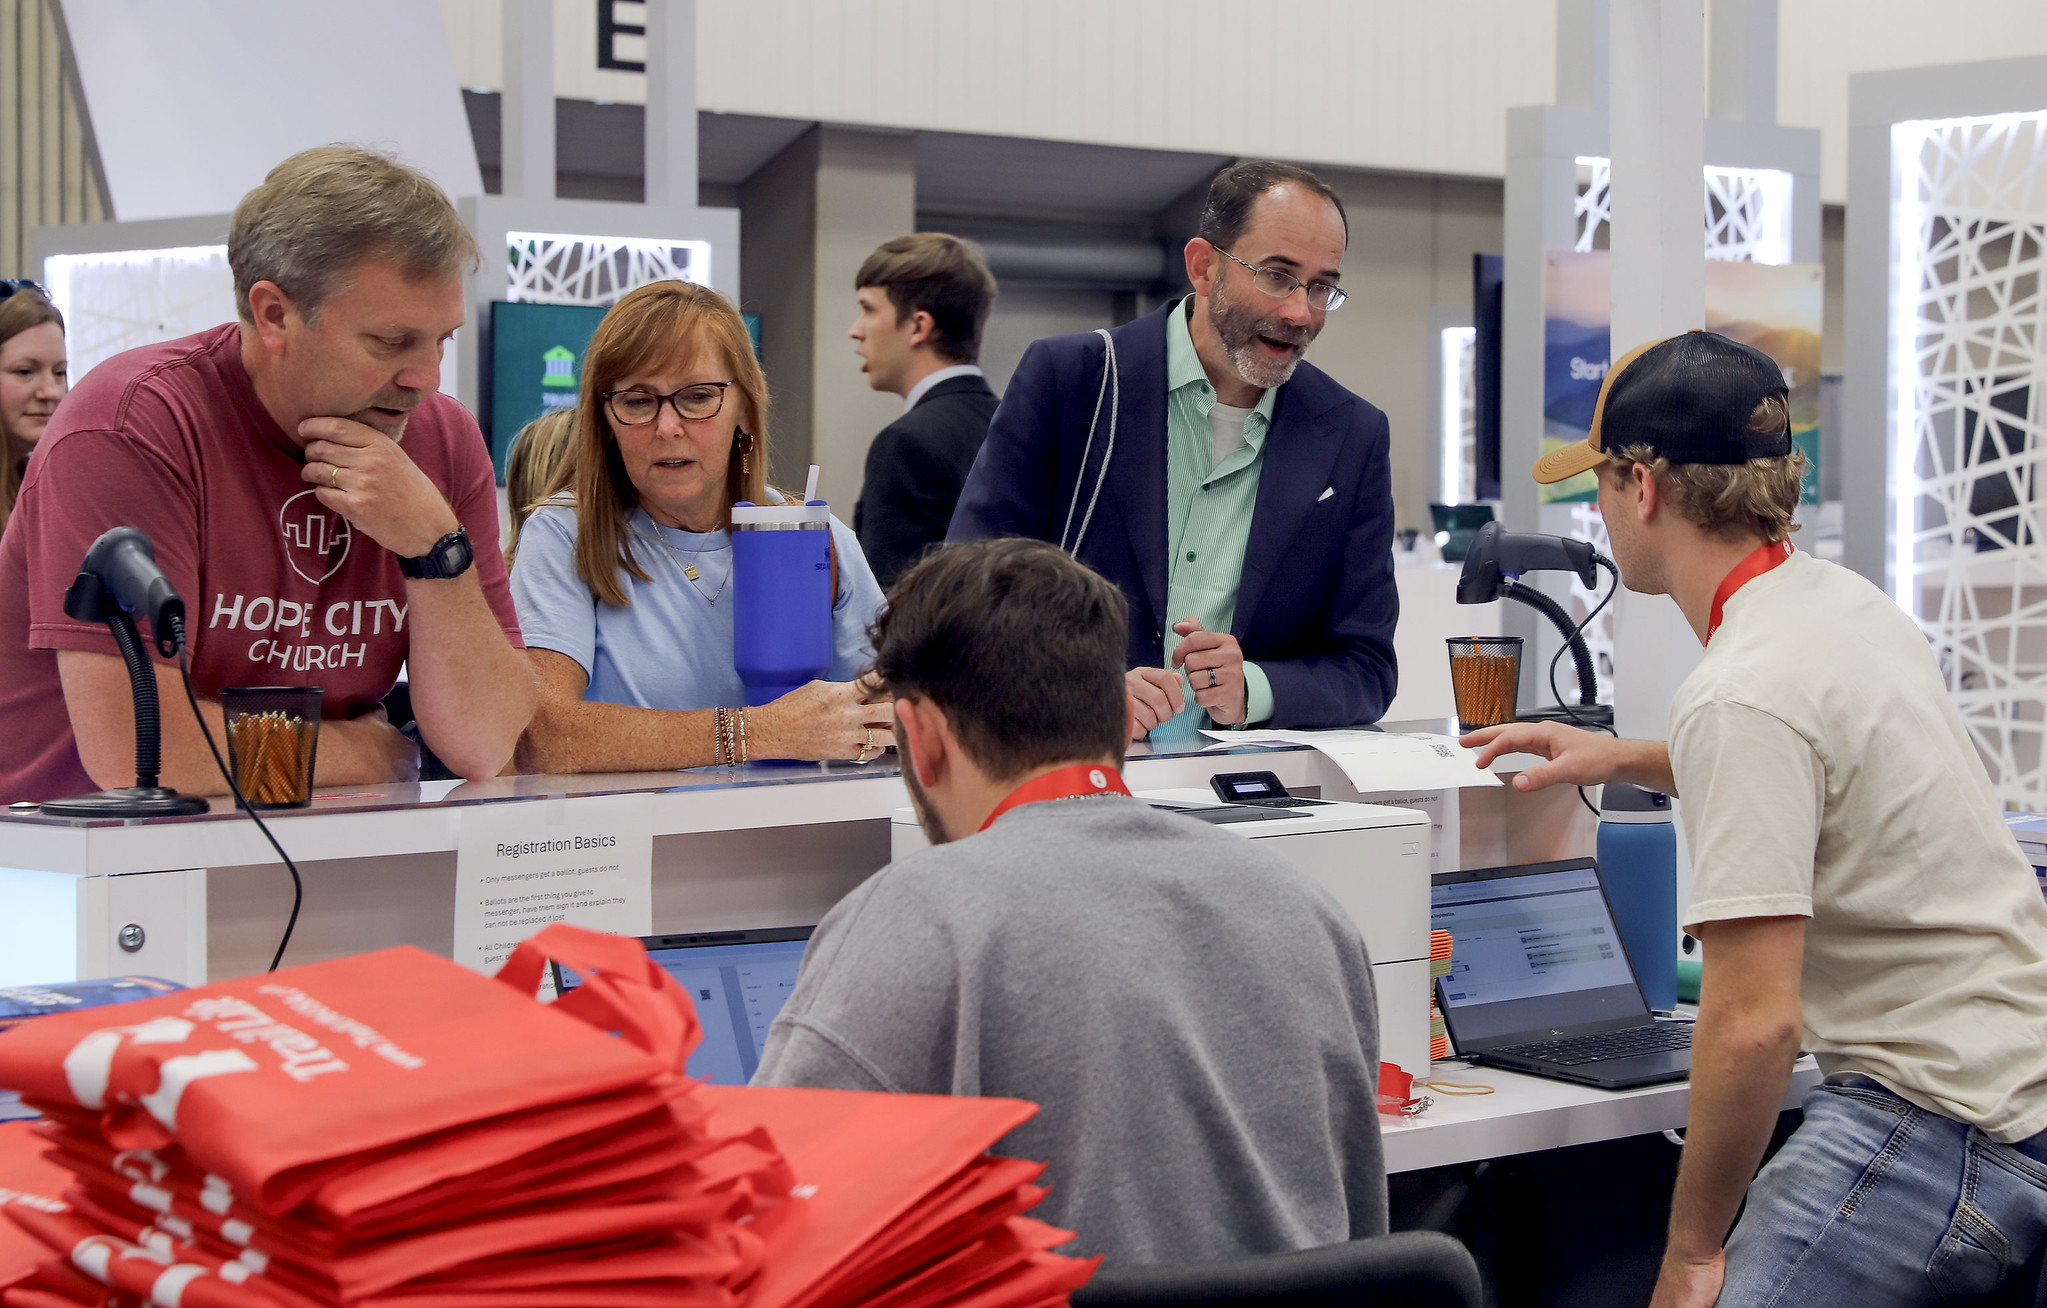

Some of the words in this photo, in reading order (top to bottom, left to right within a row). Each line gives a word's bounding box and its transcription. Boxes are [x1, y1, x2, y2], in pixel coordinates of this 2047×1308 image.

[209, 593, 313, 638] HOPE
[325, 599, 409, 636] CITY
[248, 639, 366, 671] CHURCH
[496, 837, 571, 859] Registration
[574, 834, 616, 850] Basics
[485, 875, 500, 884] Only
[501, 872, 539, 883] messengers
[540, 870, 550, 880] get
[556, 867, 576, 877] ballot,
[578, 865, 598, 875] guests
[599, 864, 606, 872] do
[607, 863, 619, 871] not
[485, 896, 507, 907] Ballots
[508, 896, 518, 904] are
[519, 894, 530, 902] the
[530, 893, 543, 902] first
[544, 891, 560, 901] thing
[561, 891, 573, 900] you
[573, 889, 586, 899] give
[586, 888, 594, 896] to
[522, 905, 537, 914] have
[538, 903, 555, 912] them
[556, 902, 569, 911] sign
[570, 901, 575, 909] it
[575, 900, 588, 908] and
[589, 898, 612, 908] explain
[612, 896, 626, 905] they
[484, 921, 496, 929] can
[497, 919, 508, 927] not
[509, 917, 518, 925] be
[518, 914, 546, 925] replaced
[547, 913, 552, 921] if
[552, 912, 565, 921] lost
[484, 943, 493, 951] All
